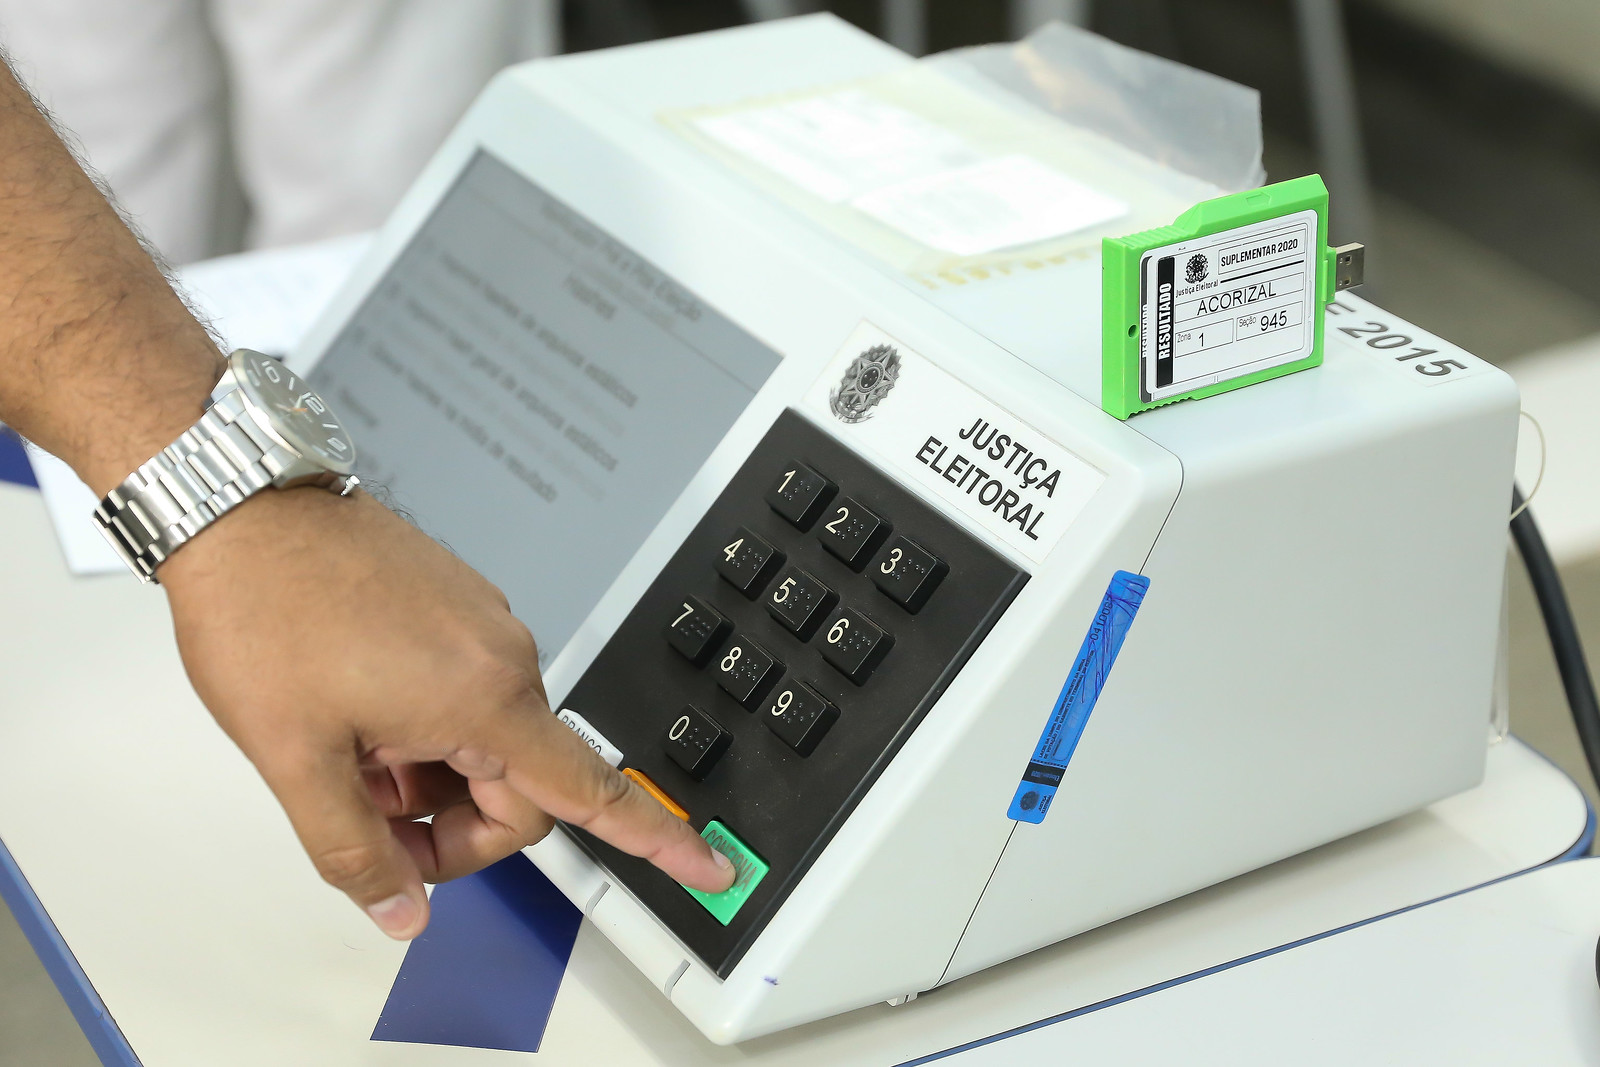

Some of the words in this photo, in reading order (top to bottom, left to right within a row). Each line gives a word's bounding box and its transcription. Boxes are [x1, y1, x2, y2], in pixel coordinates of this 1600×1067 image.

[1221, 244, 1277, 267] SUPLEMENTAR
[1278, 238, 1298, 254] 2020
[1176, 286, 1195, 298] Justiça
[1196, 279, 1219, 292] Eleitoral
[1197, 282, 1277, 316] ACORIZAL
[1158, 282, 1172, 360] RESULTADO
[1239, 316, 1257, 328] Seção
[1260, 310, 1288, 332] 945
[1177, 333, 1192, 343] Zona
[1198, 333, 1204, 347] 1
[1337, 322, 1468, 377] 2015
[261, 360, 280, 383] 10
[301, 391, 325, 415] 12
[959, 418, 1061, 498] JUSTIÇA
[777, 470, 796, 493] 1
[915, 436, 1044, 541] ELEITORAL
[825, 507, 849, 534] 2
[723, 538, 745, 562] 4
[880, 548, 902, 574] 3
[773, 577, 796, 603] 5
[671, 603, 694, 627] 7
[827, 618, 849, 644] 6
[720, 647, 742, 672] 8
[771, 690, 793, 716] 9
[668, 715, 690, 740] 0
